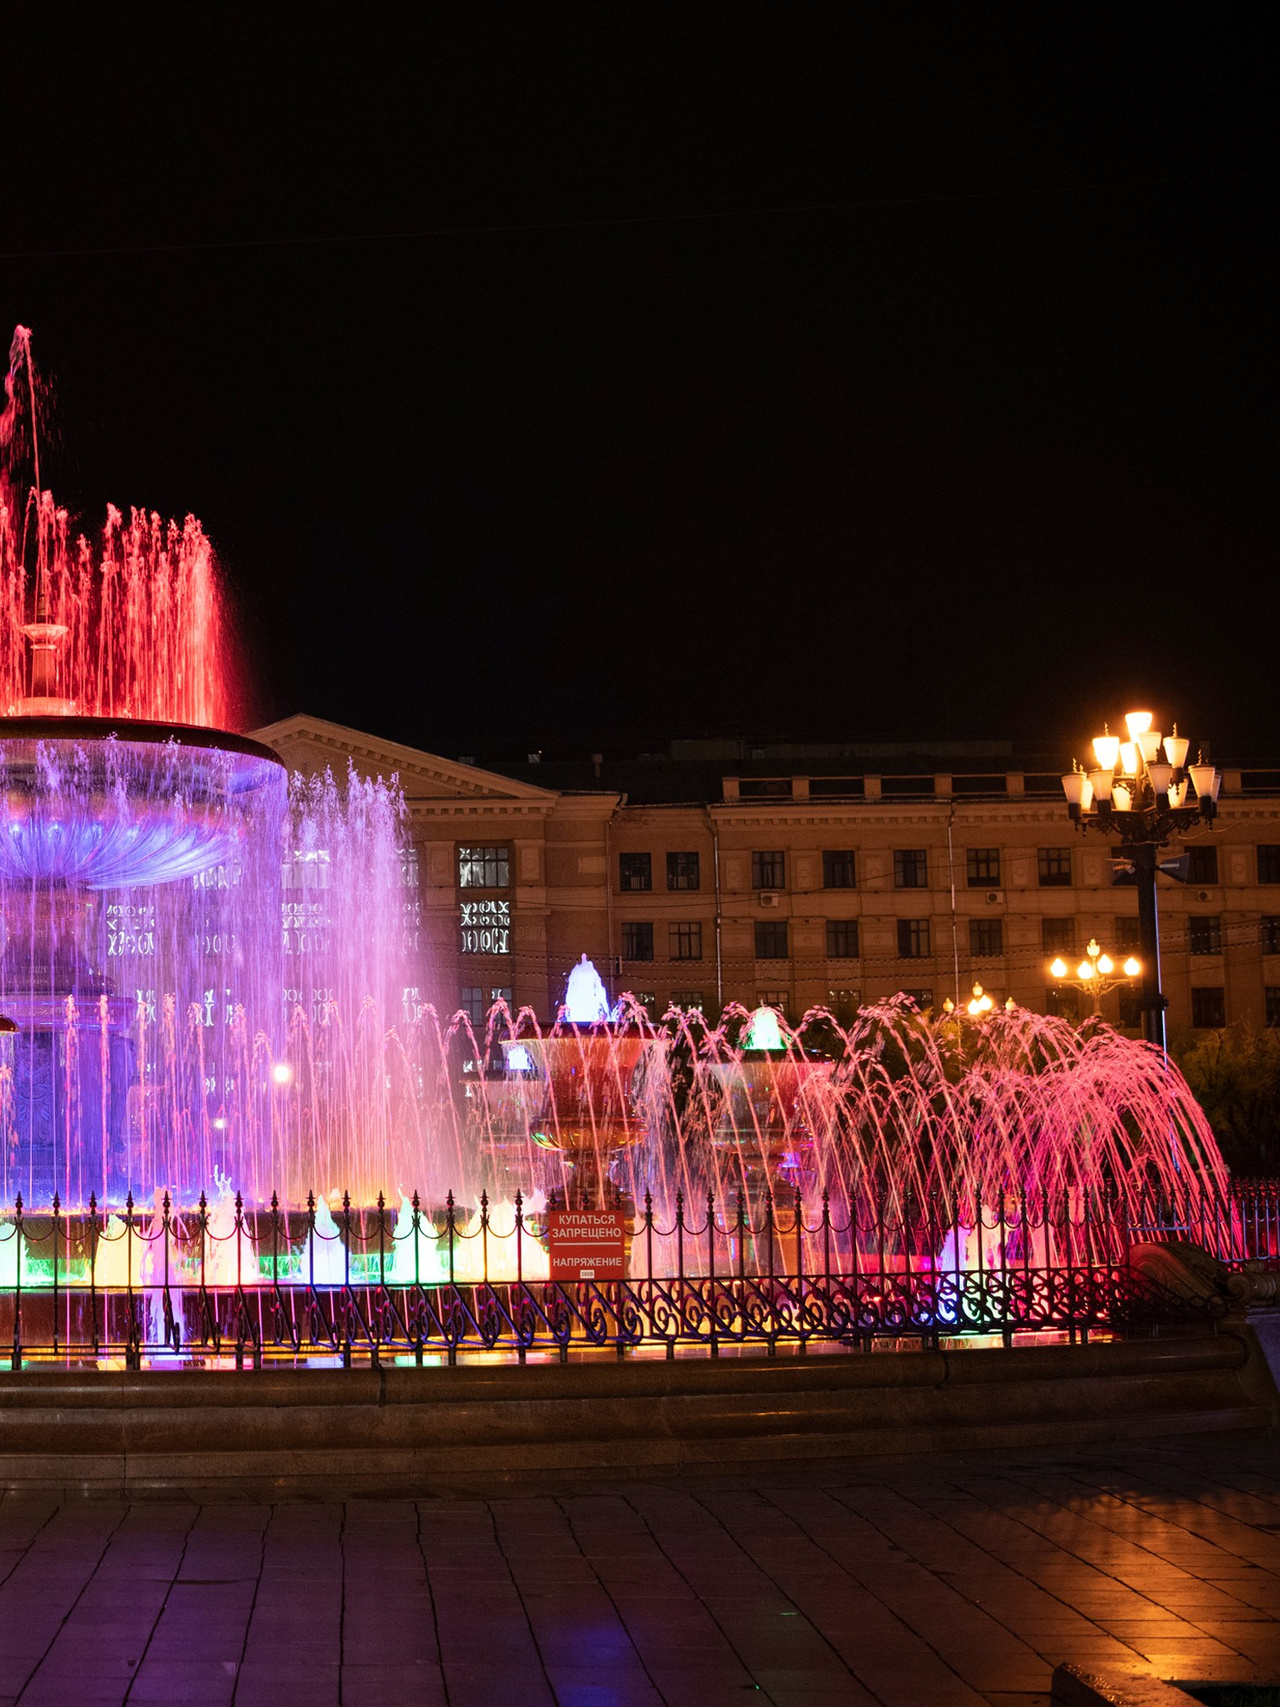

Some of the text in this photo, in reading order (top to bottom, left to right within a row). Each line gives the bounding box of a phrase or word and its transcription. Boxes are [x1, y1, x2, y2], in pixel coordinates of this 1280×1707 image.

[559, 1214, 616, 1225] КУПАТЬСЯ
[552, 1227, 622, 1239] ЗАПРЕЩЕНО
[552, 1257, 622, 1267] НАПРЯЖЕНИЕ
